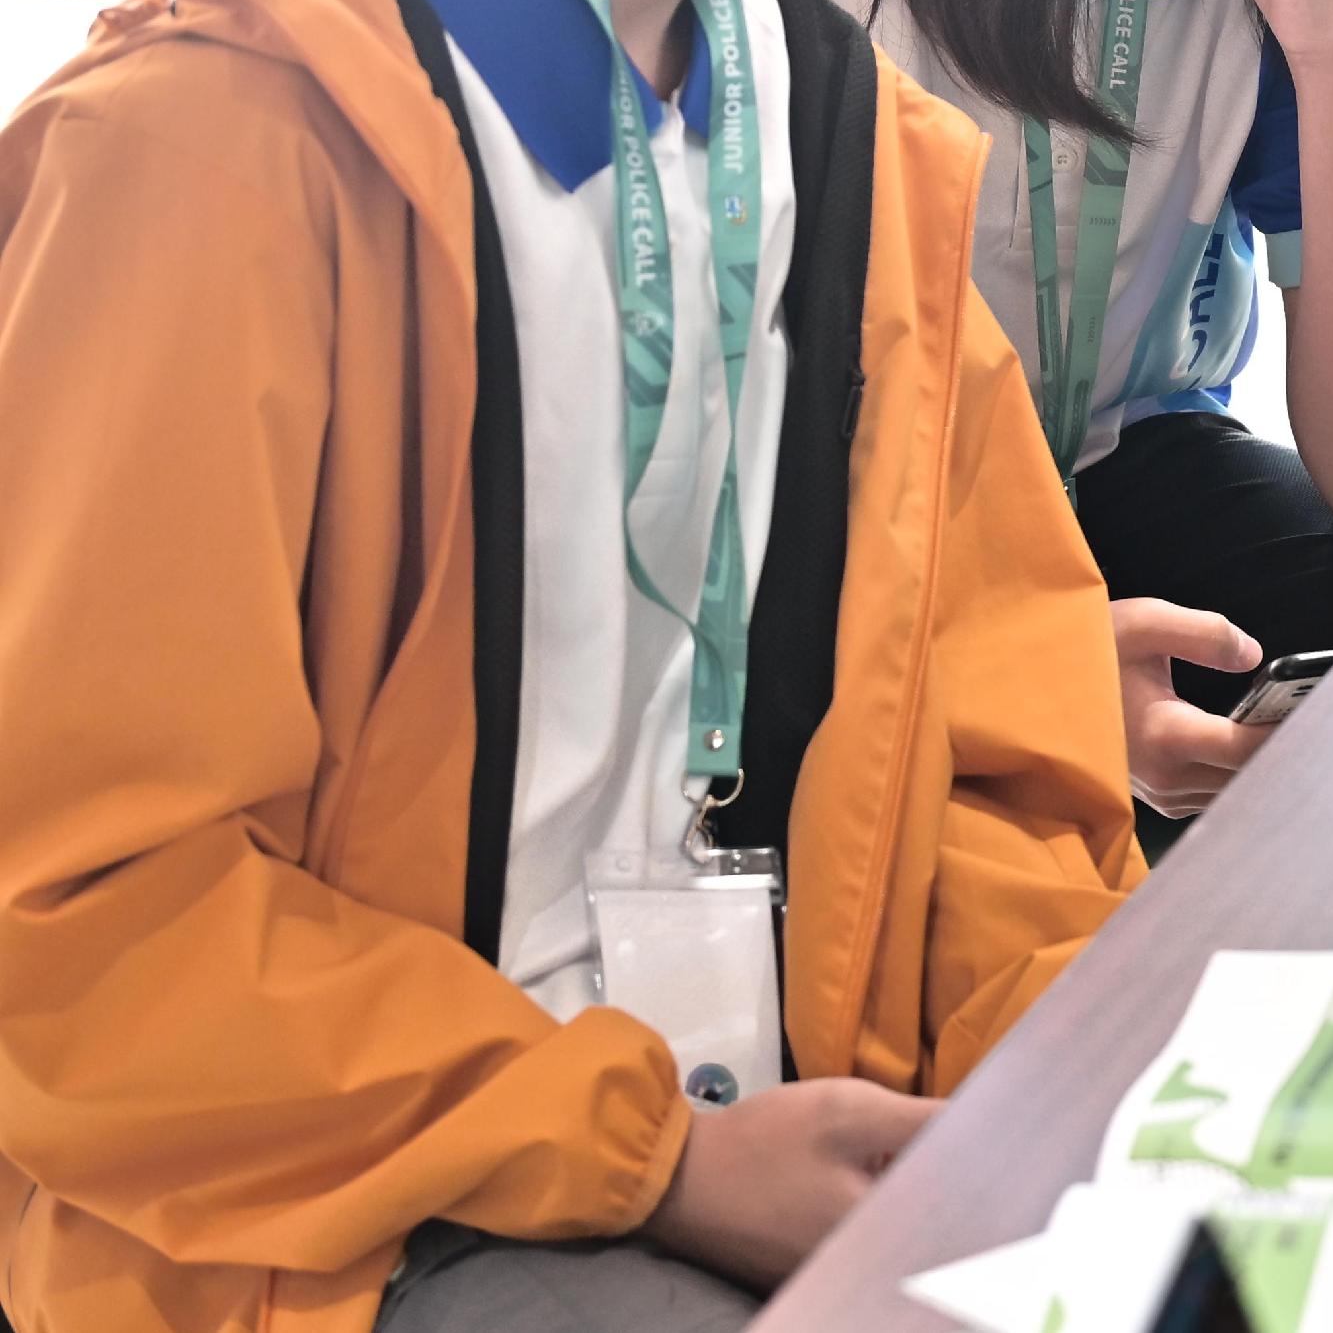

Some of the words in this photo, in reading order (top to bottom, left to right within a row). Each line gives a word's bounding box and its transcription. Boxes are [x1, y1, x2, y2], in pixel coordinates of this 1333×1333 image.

[1109, 42, 1131, 90] CALL
[722, 82, 743, 173] JUNIOR
[623, 135, 651, 218] POLICE
[631, 224, 657, 287] CALL
